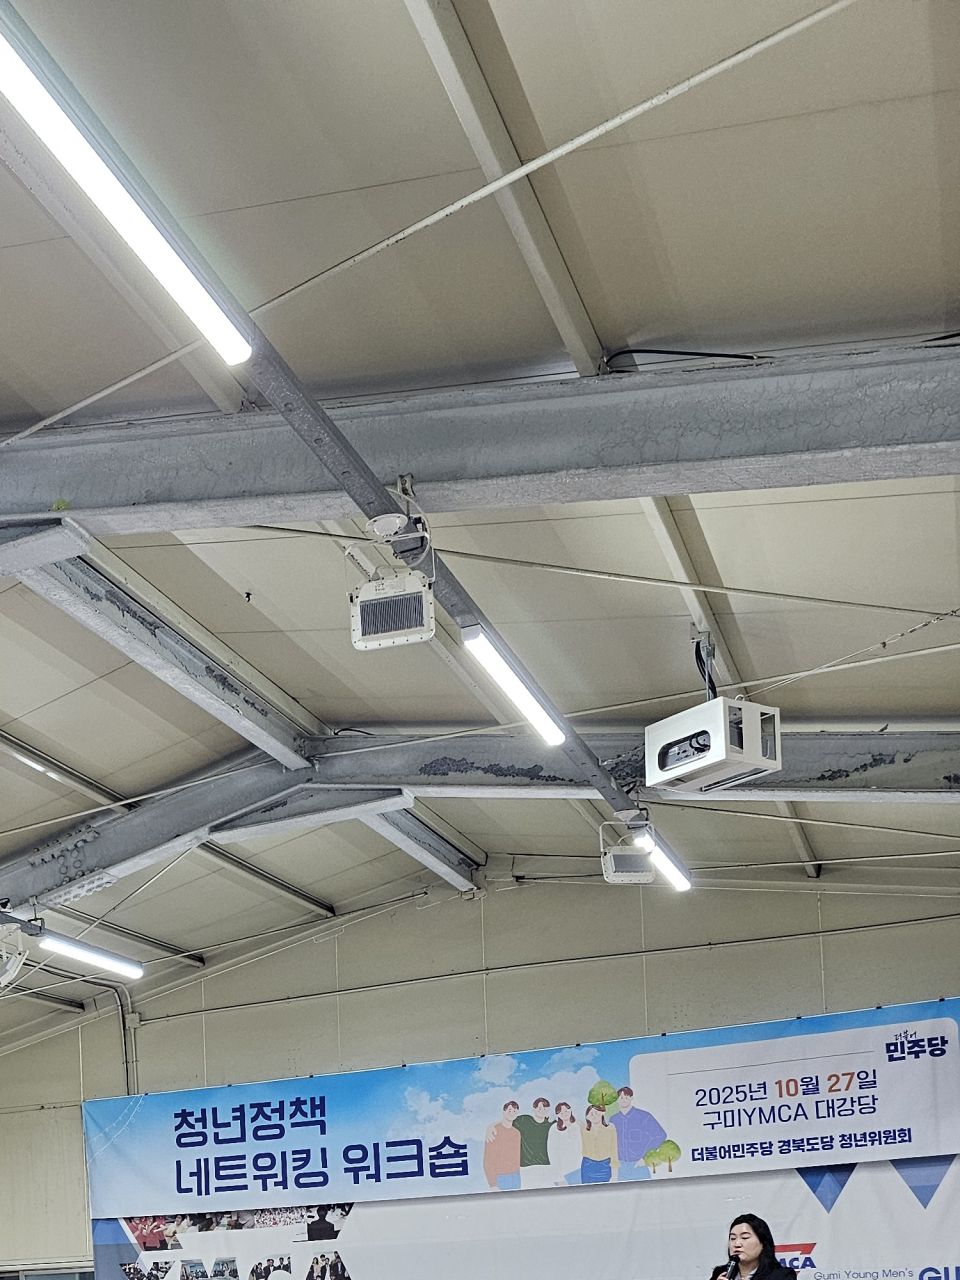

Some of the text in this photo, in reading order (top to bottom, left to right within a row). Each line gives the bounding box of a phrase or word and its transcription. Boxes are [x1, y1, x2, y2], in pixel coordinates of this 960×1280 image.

[885, 1036, 949, 1062] 민주당
[695, 1069, 878, 1107] 2025년 10월 27일
[174, 1096, 326, 1148] 청년정책
[703, 1094, 879, 1131] 구미YMCA 대강당
[691, 1127, 913, 1163] 더불어민주당 경북도당 청년위원회
[175, 1136, 469, 1196] 네트워킹 워크숍
[814, 1267, 914, 1280] Gumi Young Men's
